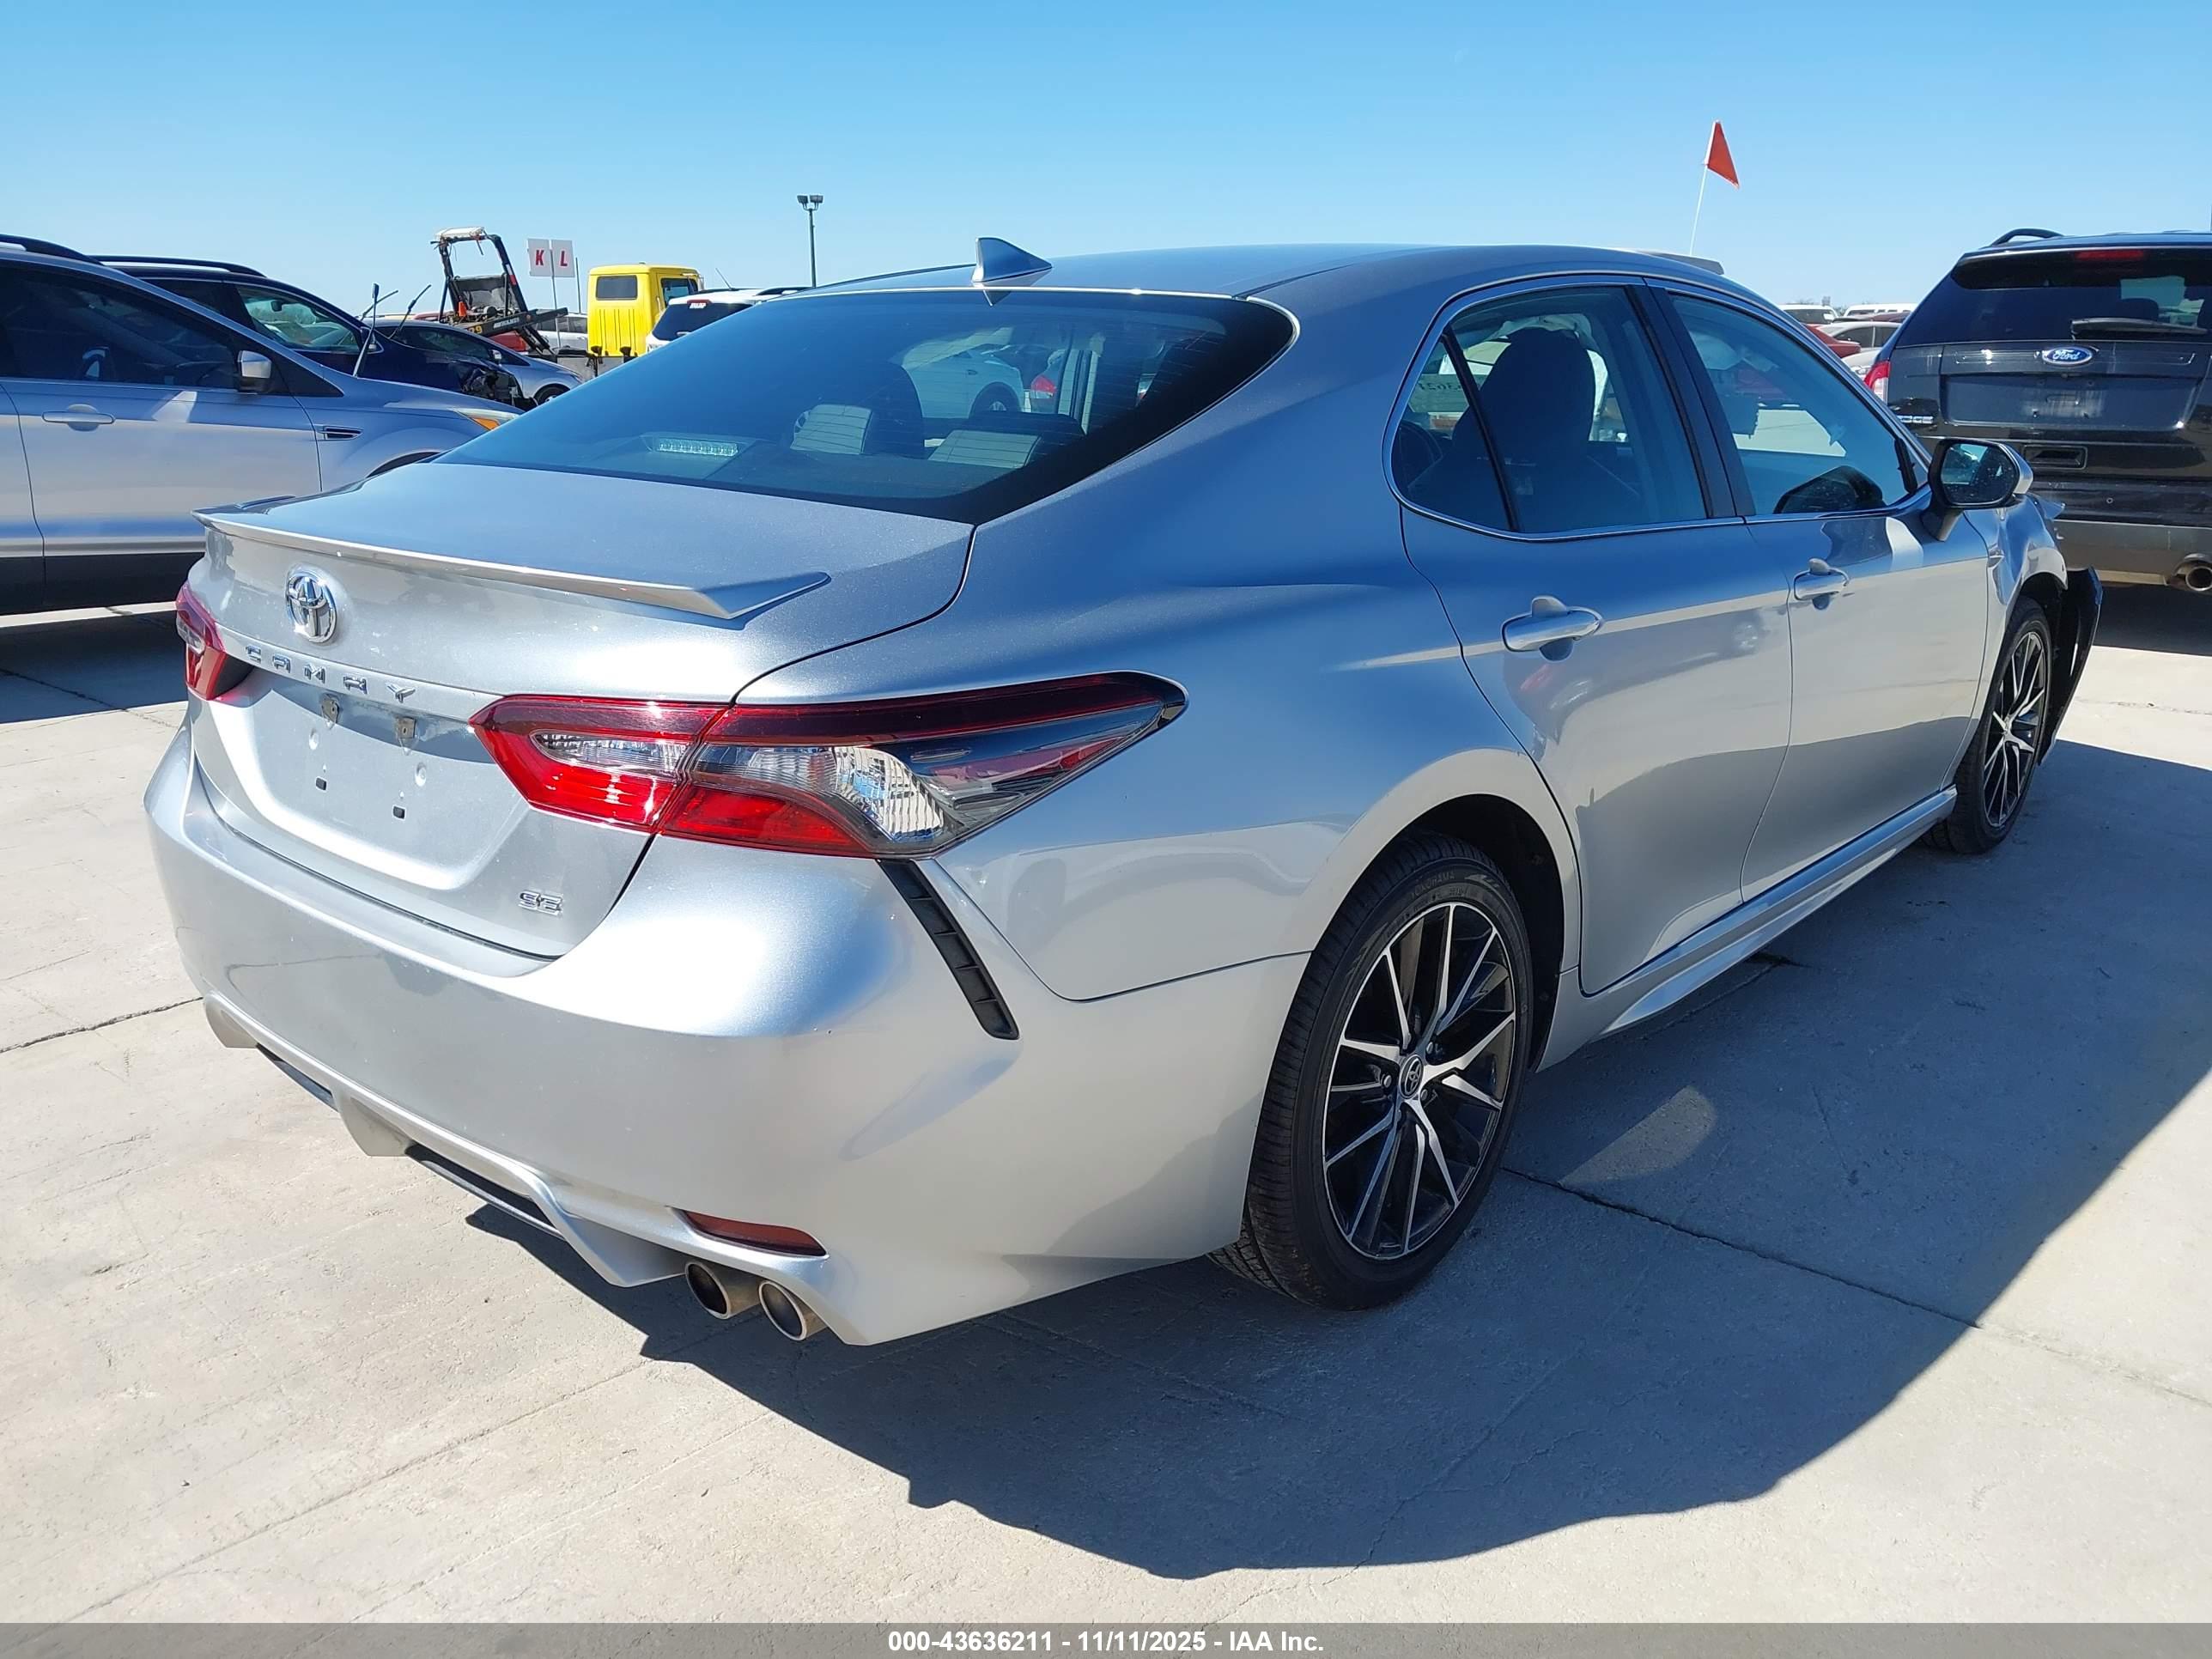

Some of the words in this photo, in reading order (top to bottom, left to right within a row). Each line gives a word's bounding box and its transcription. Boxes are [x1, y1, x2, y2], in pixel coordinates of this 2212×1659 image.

[535, 249, 544, 266] K
[560, 250, 568, 267] L
[2052, 349, 2081, 361] Ford
[245, 644, 417, 704] CAMRY
[517, 889, 563, 916] SE
